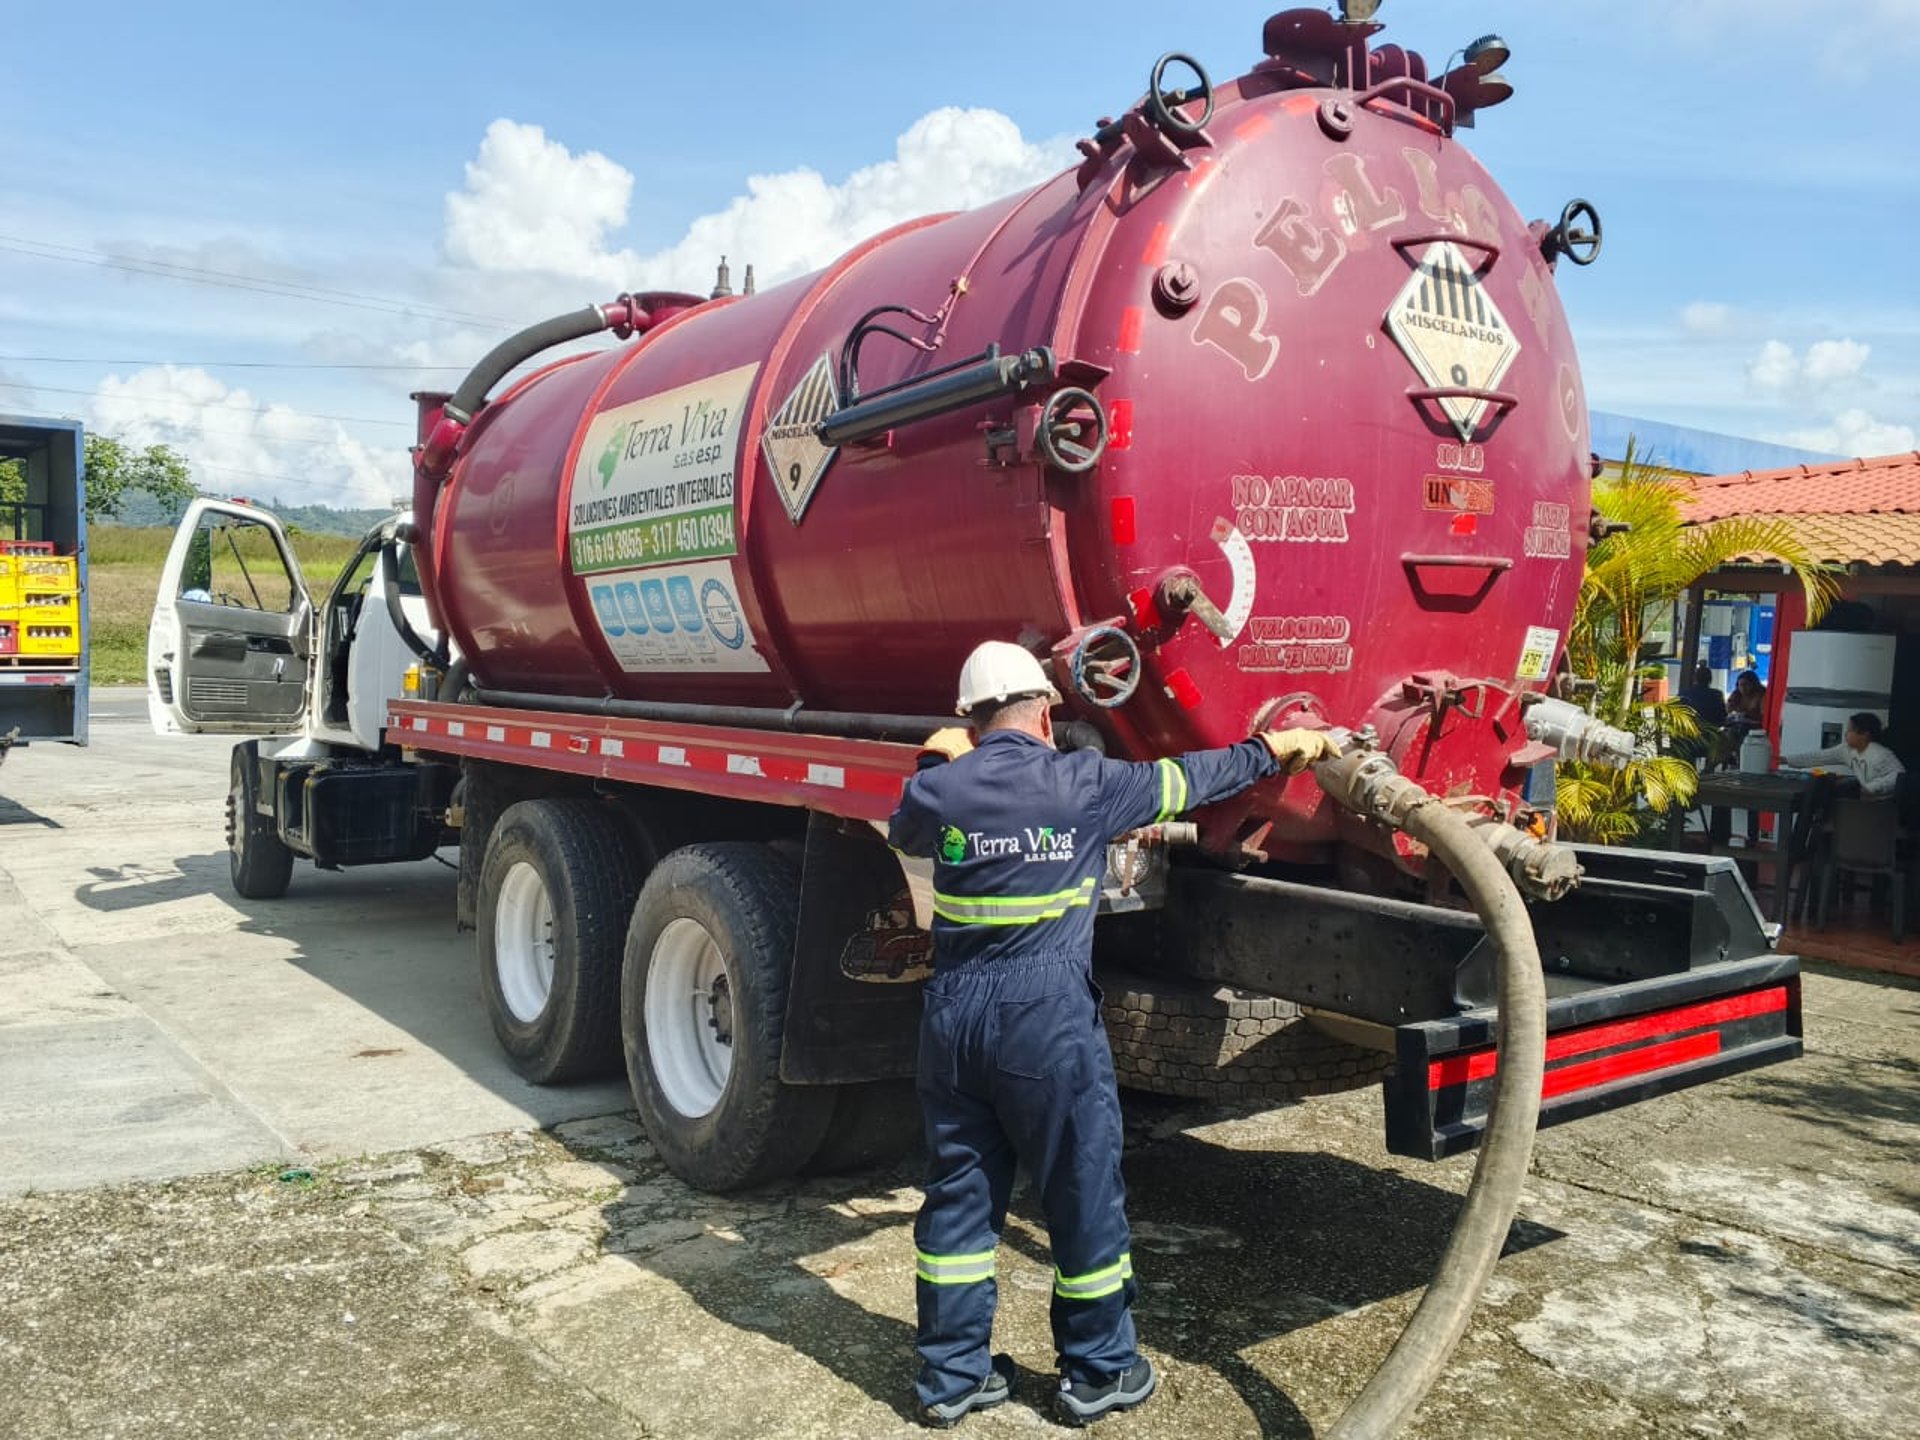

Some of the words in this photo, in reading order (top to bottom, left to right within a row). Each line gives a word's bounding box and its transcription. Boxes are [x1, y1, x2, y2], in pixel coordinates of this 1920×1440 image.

[1405, 311, 1504, 346] MISCELANEOS
[624, 418, 673, 461] Terra
[680, 400, 728, 445] Viva
[789, 462, 802, 491] 9
[1232, 476, 1267, 508] NO
[1268, 476, 1353, 511] APAGAR
[574, 498, 618, 526] SOLUCIONES
[619, 484, 675, 517] AMBIENTALES
[677, 472, 732, 507] INTEGRALES
[575, 535, 594, 565] 316
[651, 521, 673, 555] 317
[675, 514, 699, 551] 450
[700, 510, 734, 549] 0394
[1237, 508, 1284, 539] CON
[1286, 508, 1347, 541] AGUA
[1250, 617, 1348, 642] VELOCIDAD
[968, 832, 1022, 856] Terra
[1024, 826, 1074, 852] Viva
